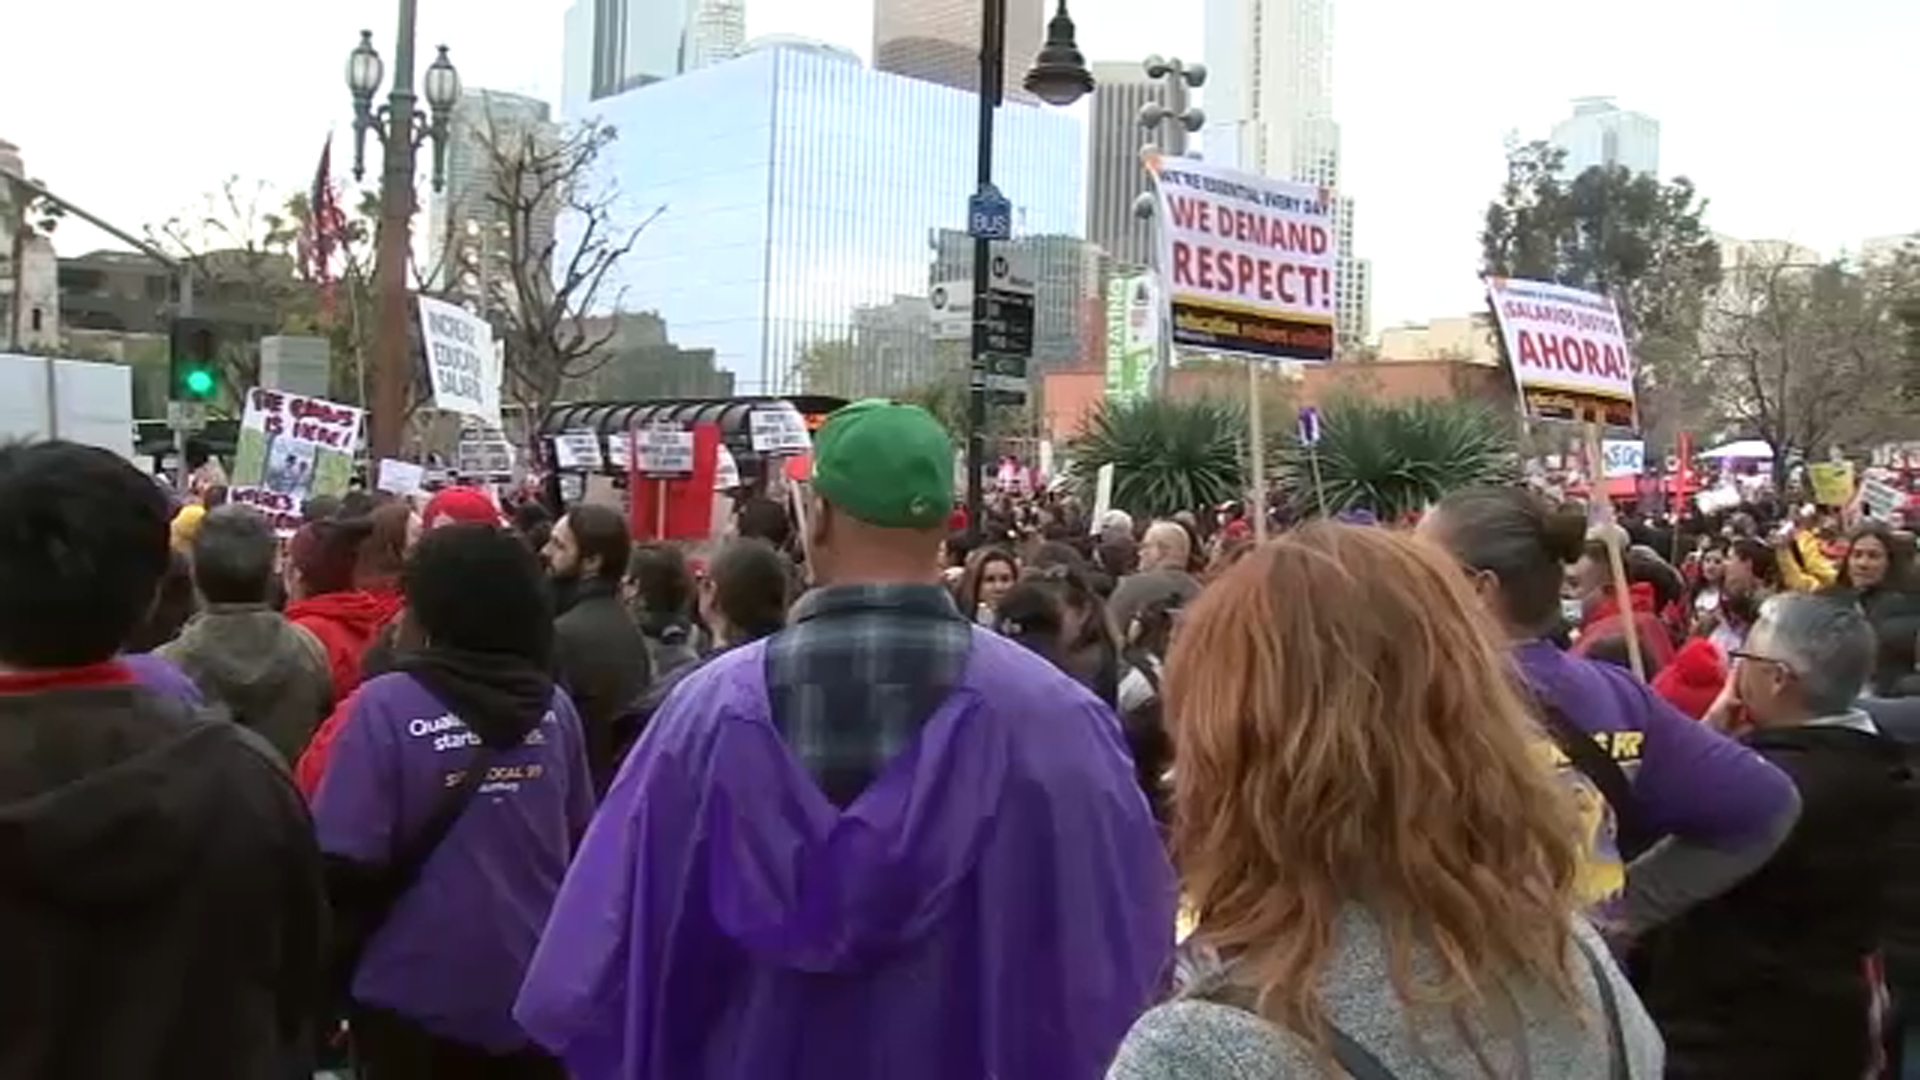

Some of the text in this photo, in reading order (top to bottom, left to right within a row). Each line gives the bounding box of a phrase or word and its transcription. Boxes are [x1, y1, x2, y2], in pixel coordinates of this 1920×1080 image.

[1263, 192, 1301, 213] EVERY
[1304, 199, 1330, 216] DAY
[973, 212, 1008, 237] BUS
[1167, 193, 1328, 256] WE DEMAND
[1172, 240, 1331, 308] RESPECT!
[1517, 329, 1628, 381] AHORA!
[264, 415, 284, 436] IS
